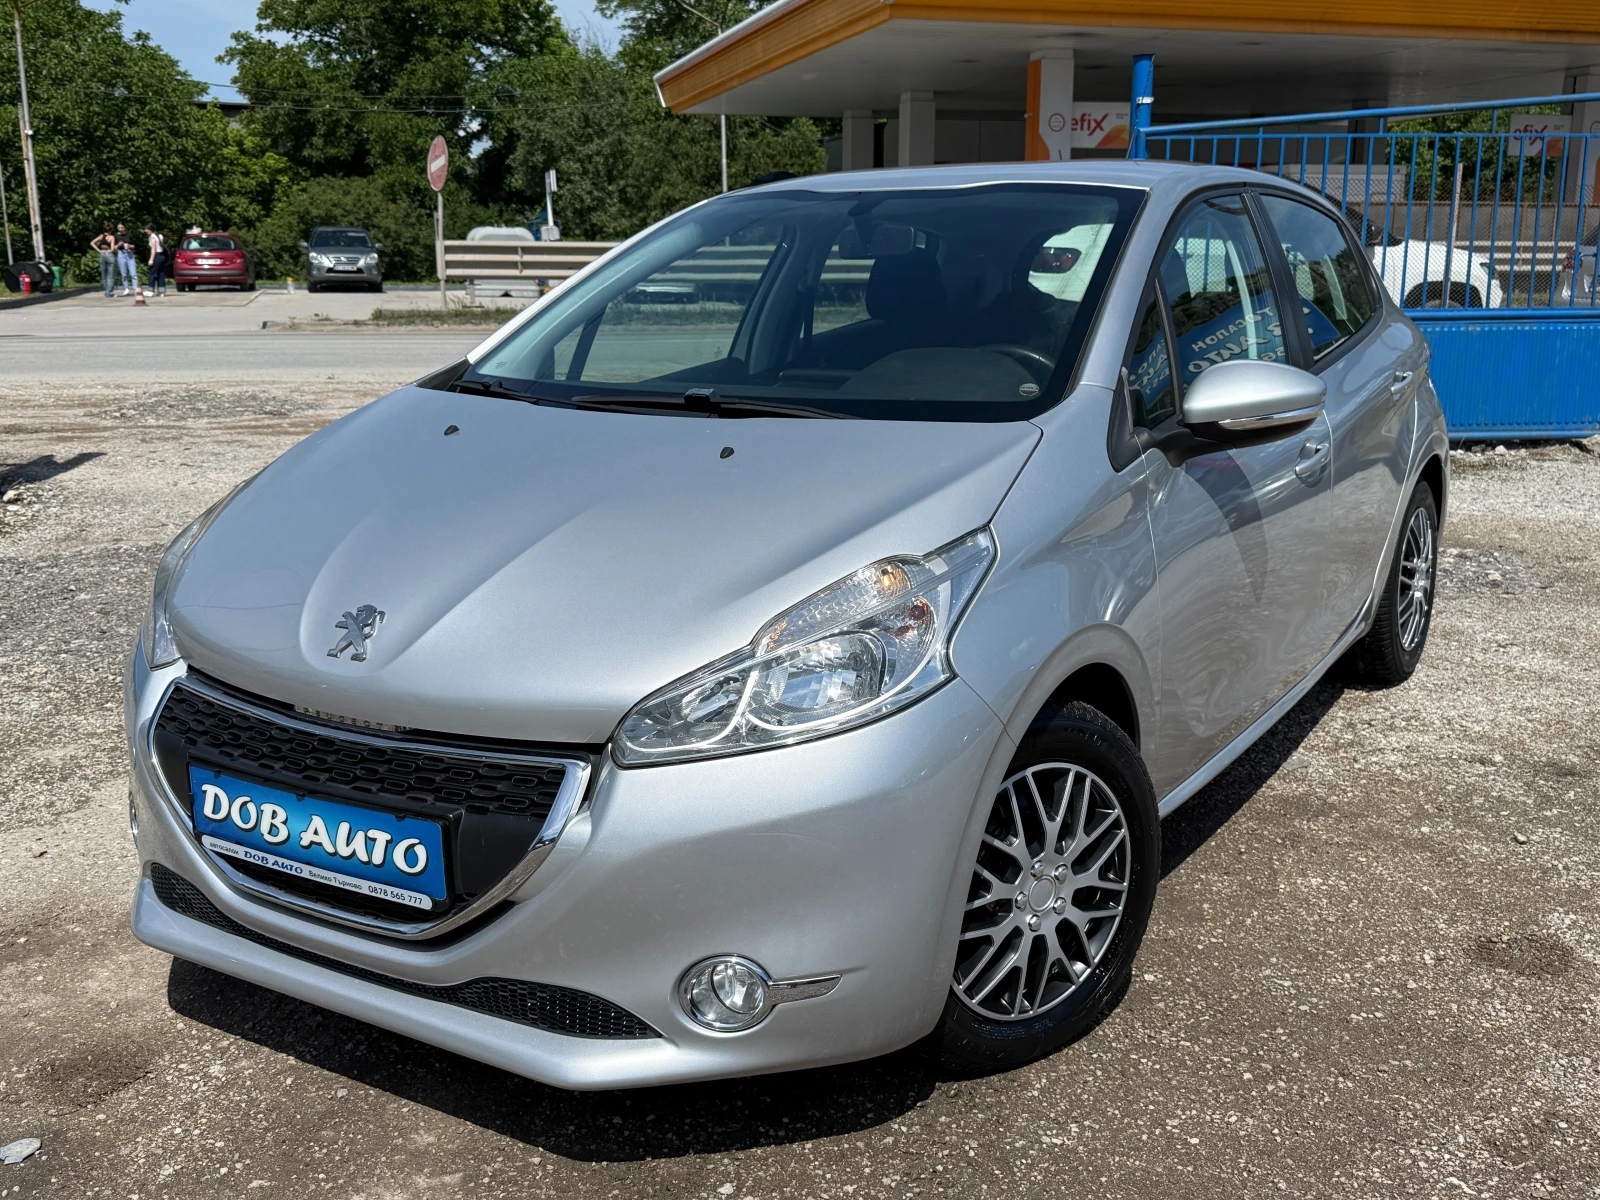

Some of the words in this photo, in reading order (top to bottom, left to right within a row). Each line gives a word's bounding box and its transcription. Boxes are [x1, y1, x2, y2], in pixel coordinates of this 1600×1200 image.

[201, 783, 290, 845] DOB
[299, 814, 428, 875] AUTO
[243, 850, 269, 865] DOB
[271, 859, 304, 875] AUTO
[368, 885, 389, 897] 0878
[390, 891, 406, 901] 565
[407, 895, 423, 905] 777
